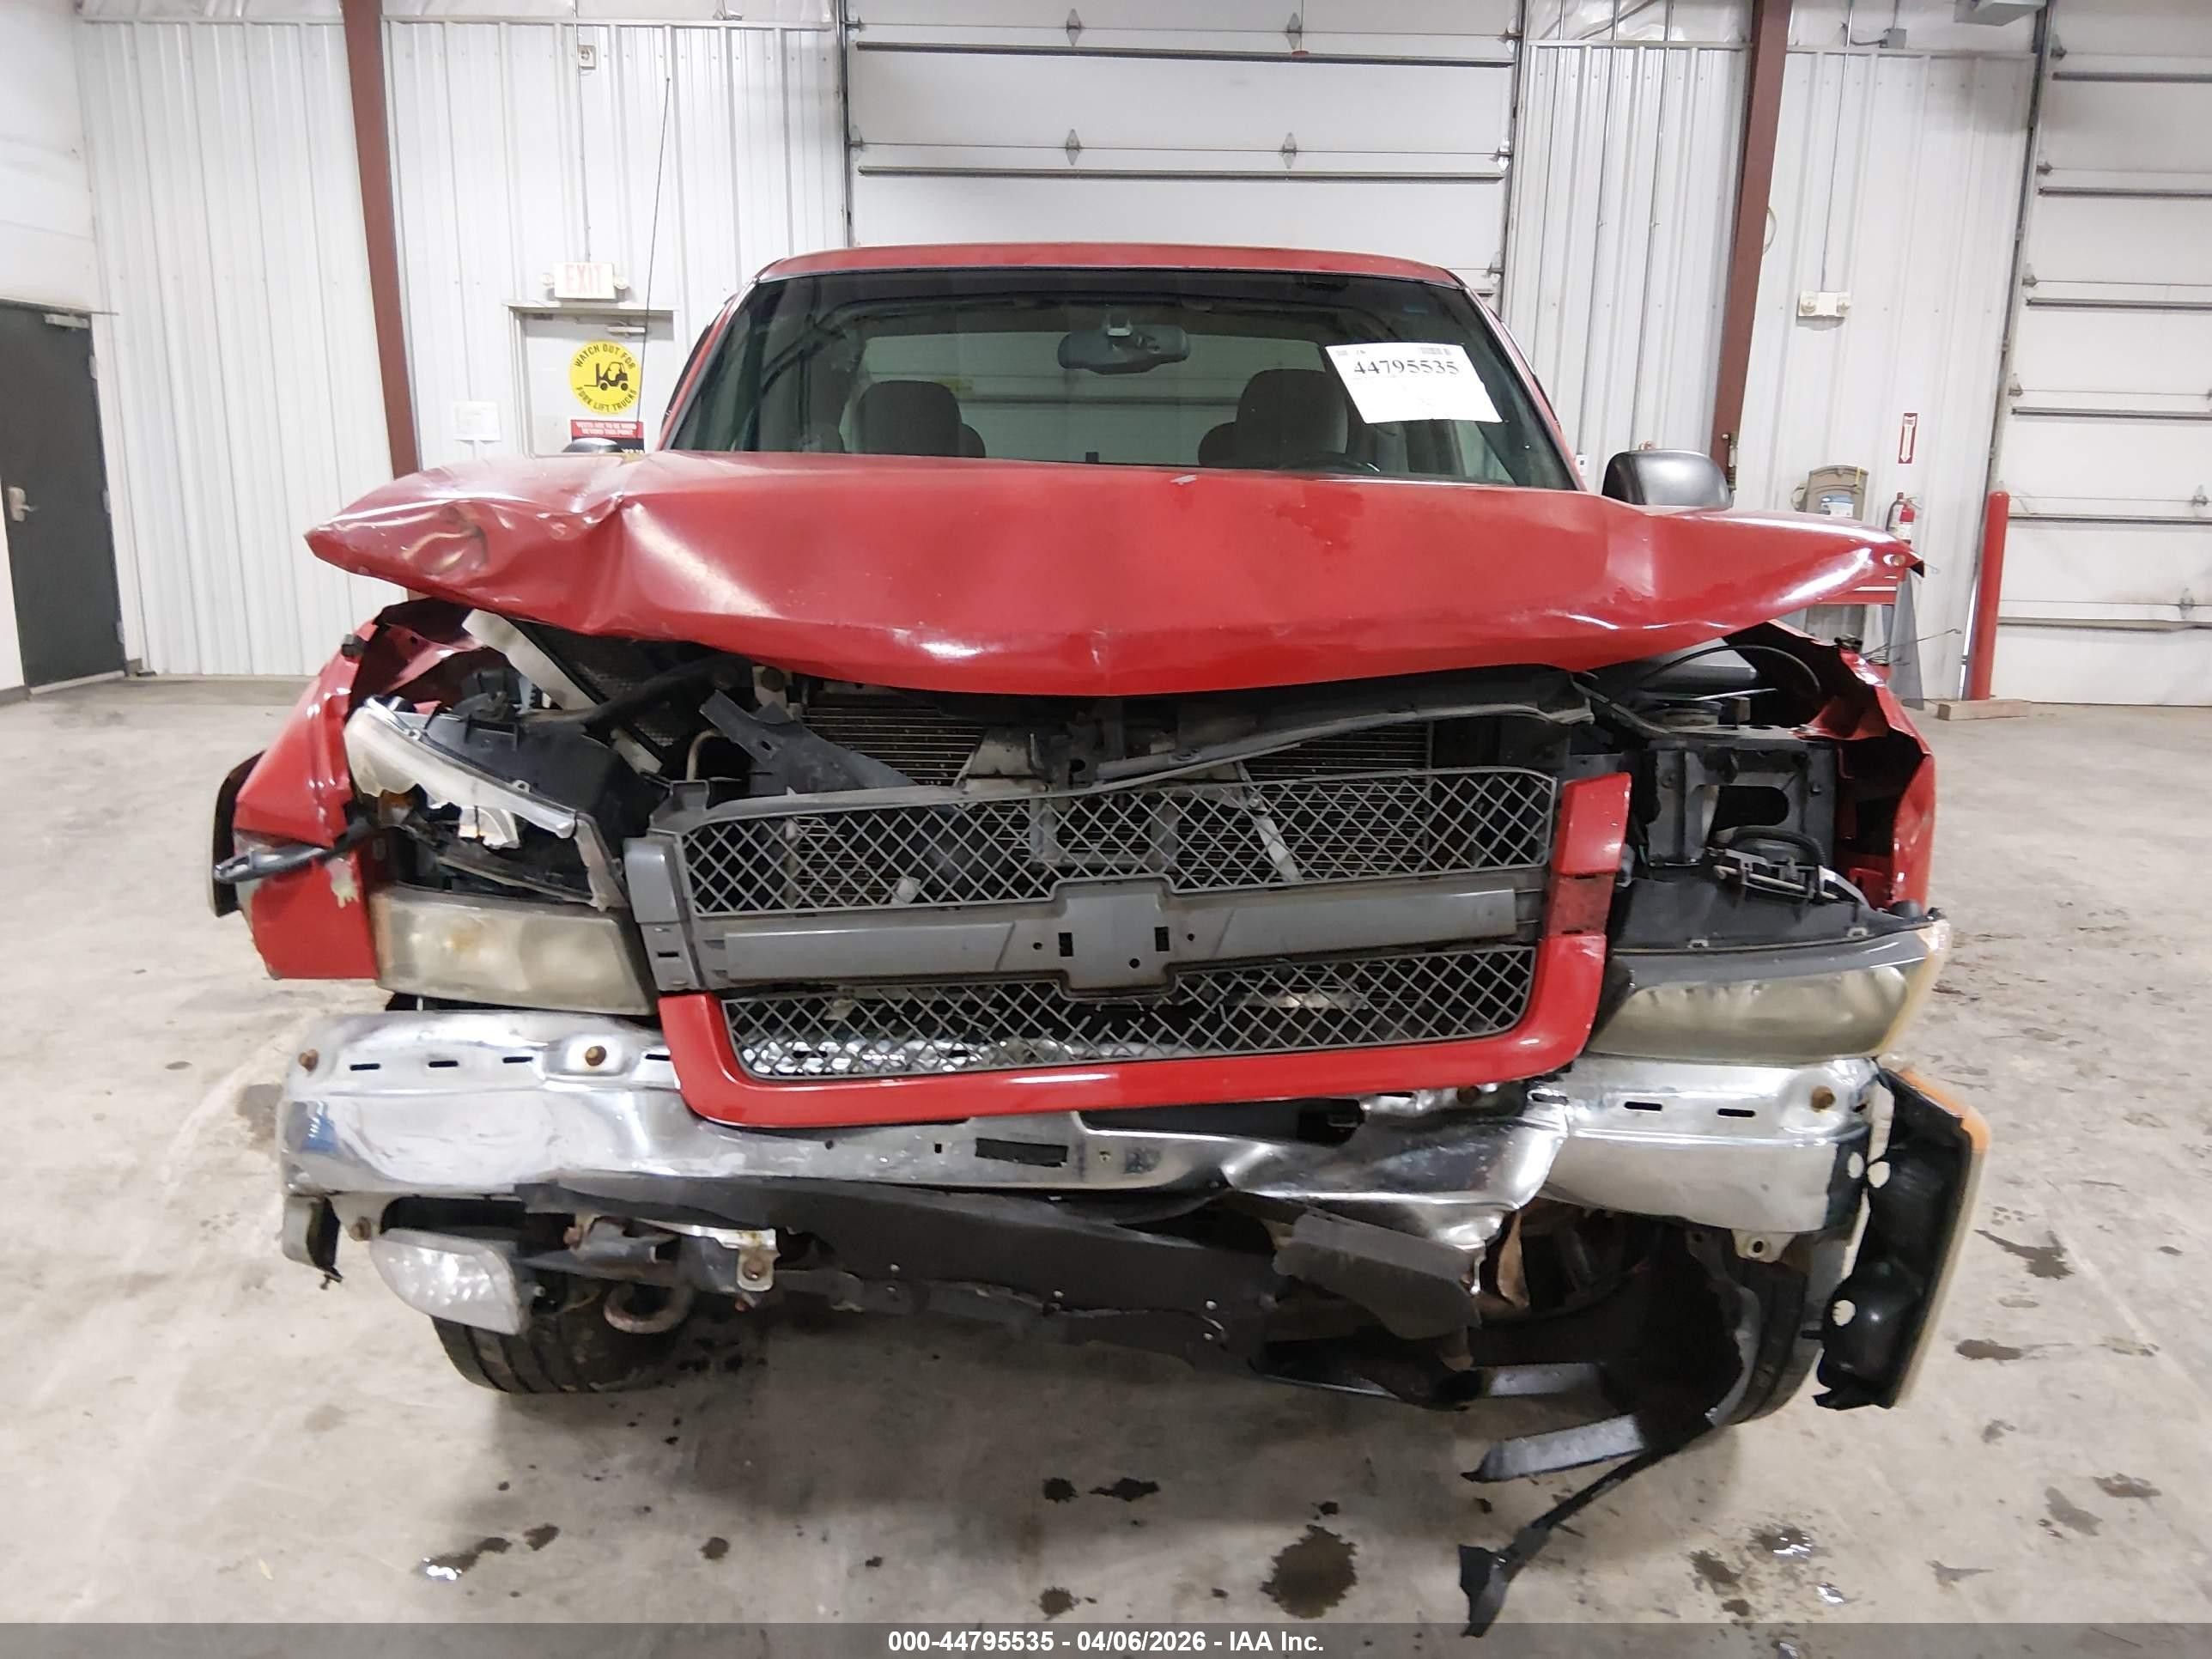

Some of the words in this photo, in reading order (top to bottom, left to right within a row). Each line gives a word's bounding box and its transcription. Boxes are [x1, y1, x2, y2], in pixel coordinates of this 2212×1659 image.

[564, 264, 603, 294] EXIT
[574, 343, 600, 368] WATCH
[602, 343, 620, 356] OUT
[620, 352, 636, 369] FOR
[1354, 360, 1460, 375] 44795535
[576, 386, 593, 406] FORK
[593, 401, 610, 412] LIFT
[611, 389, 637, 411] TRUCKS
